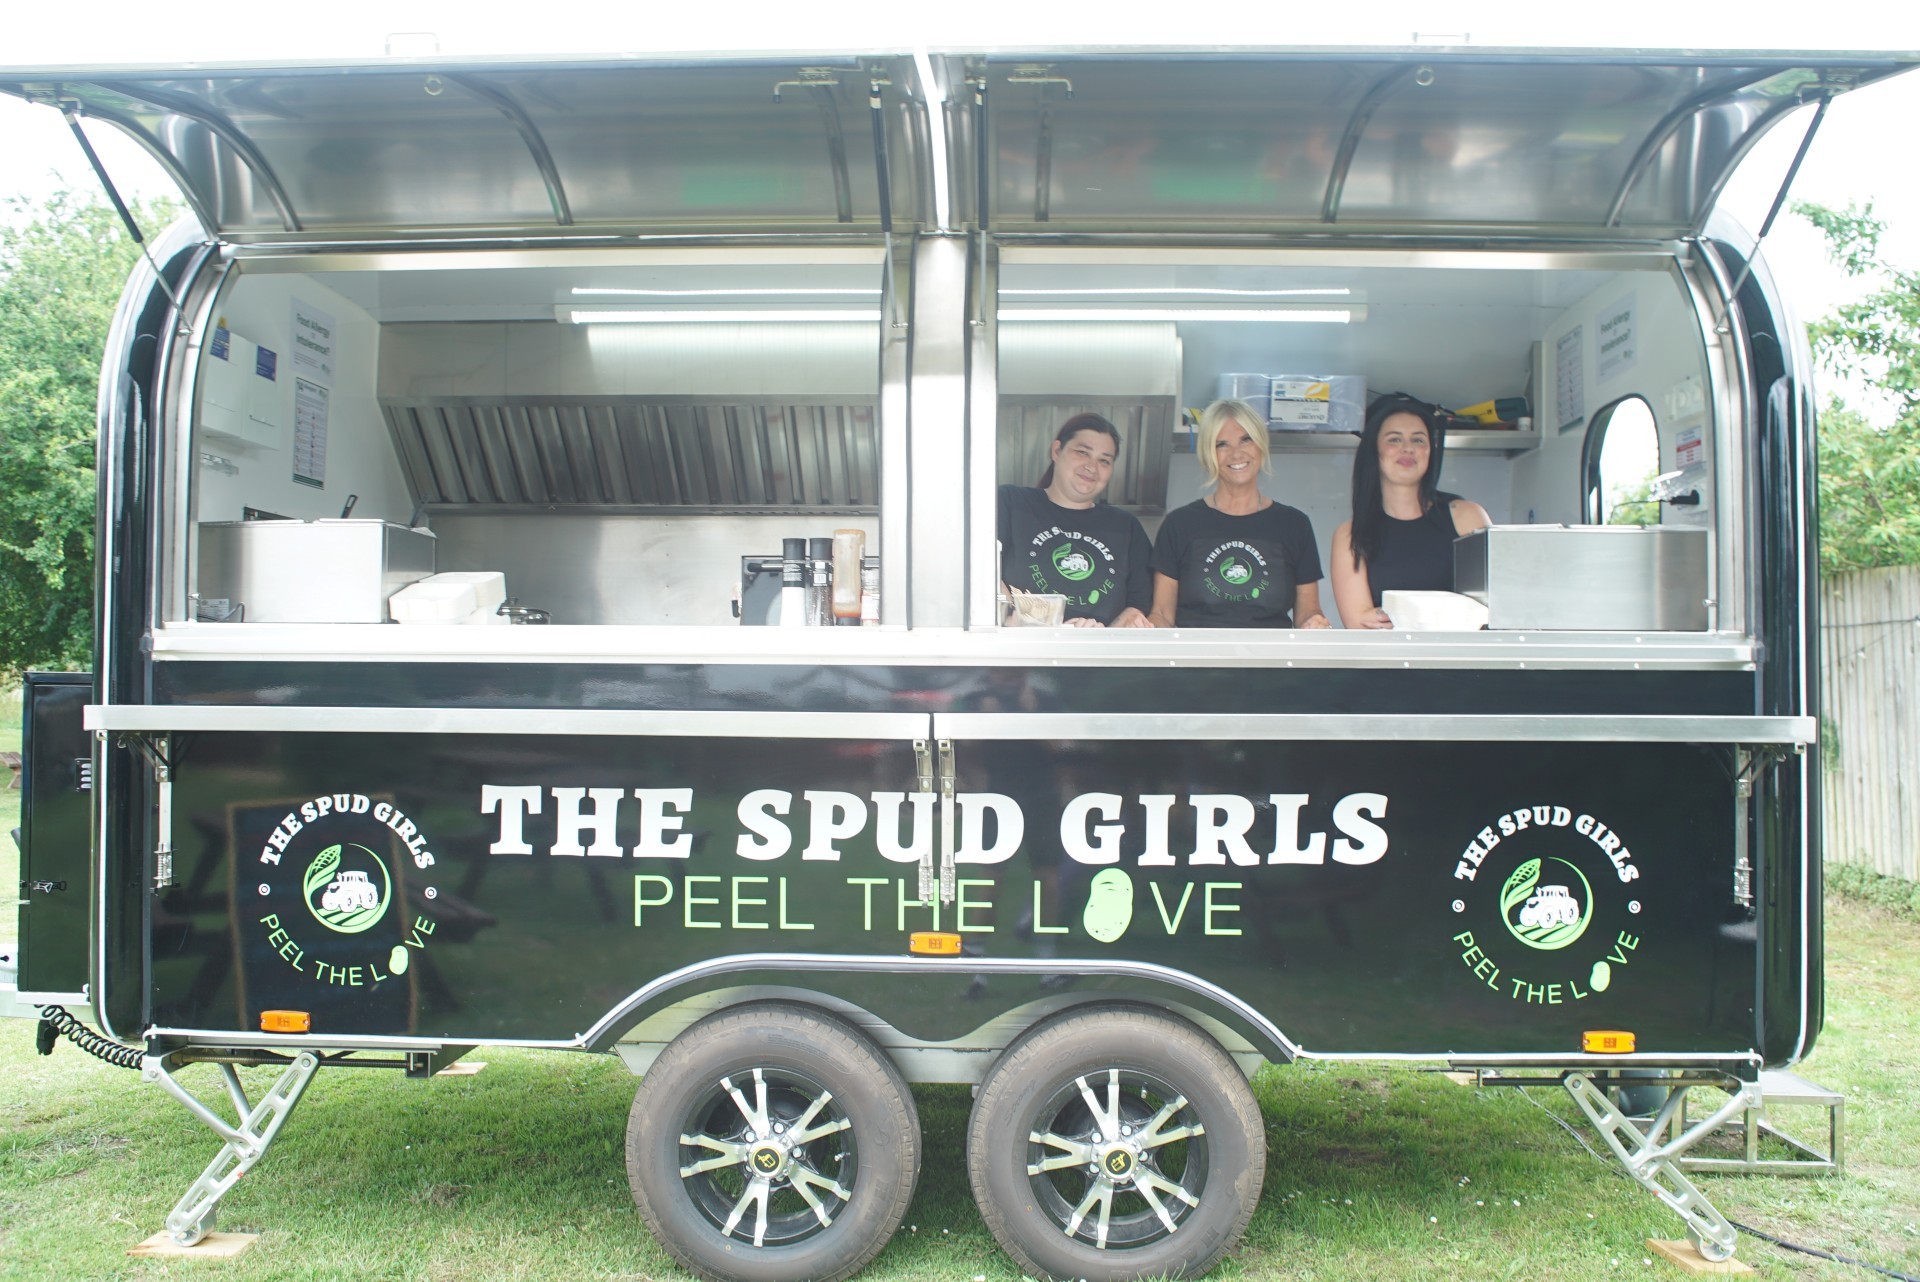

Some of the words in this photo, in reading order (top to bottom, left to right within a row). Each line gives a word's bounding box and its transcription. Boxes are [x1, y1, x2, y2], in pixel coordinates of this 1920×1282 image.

[1032, 530, 1053, 547] THE
[1051, 526, 1082, 540] SUD
[1083, 535, 1115, 561] GIRLS
[1205, 547, 1222, 564] THE
[1220, 540, 1245, 551] SPUD
[1244, 544, 1267, 567] GIRLS
[1028, 564, 1048, 594] PEEL
[1203, 577, 1221, 597] PEEL
[260, 812, 303, 866] THE
[301, 793, 370, 823] SPUD
[373, 802, 436, 869] GIRLS
[481, 784, 694, 859] THE
[736, 788, 1024, 864] SPUD
[1060, 791, 1389, 866] GIRLS
[1454, 825, 1500, 882] THE
[1498, 805, 1571, 836] SPUD
[1575, 813, 1640, 883] GIRLS
[634, 874, 815, 930] PEEL
[846, 877, 995, 933] THE
[260, 913, 304, 972] PEEL
[315, 960, 364, 986] THE
[1453, 930, 1500, 991] PEEL
[1511, 977, 1563, 1004] THE
